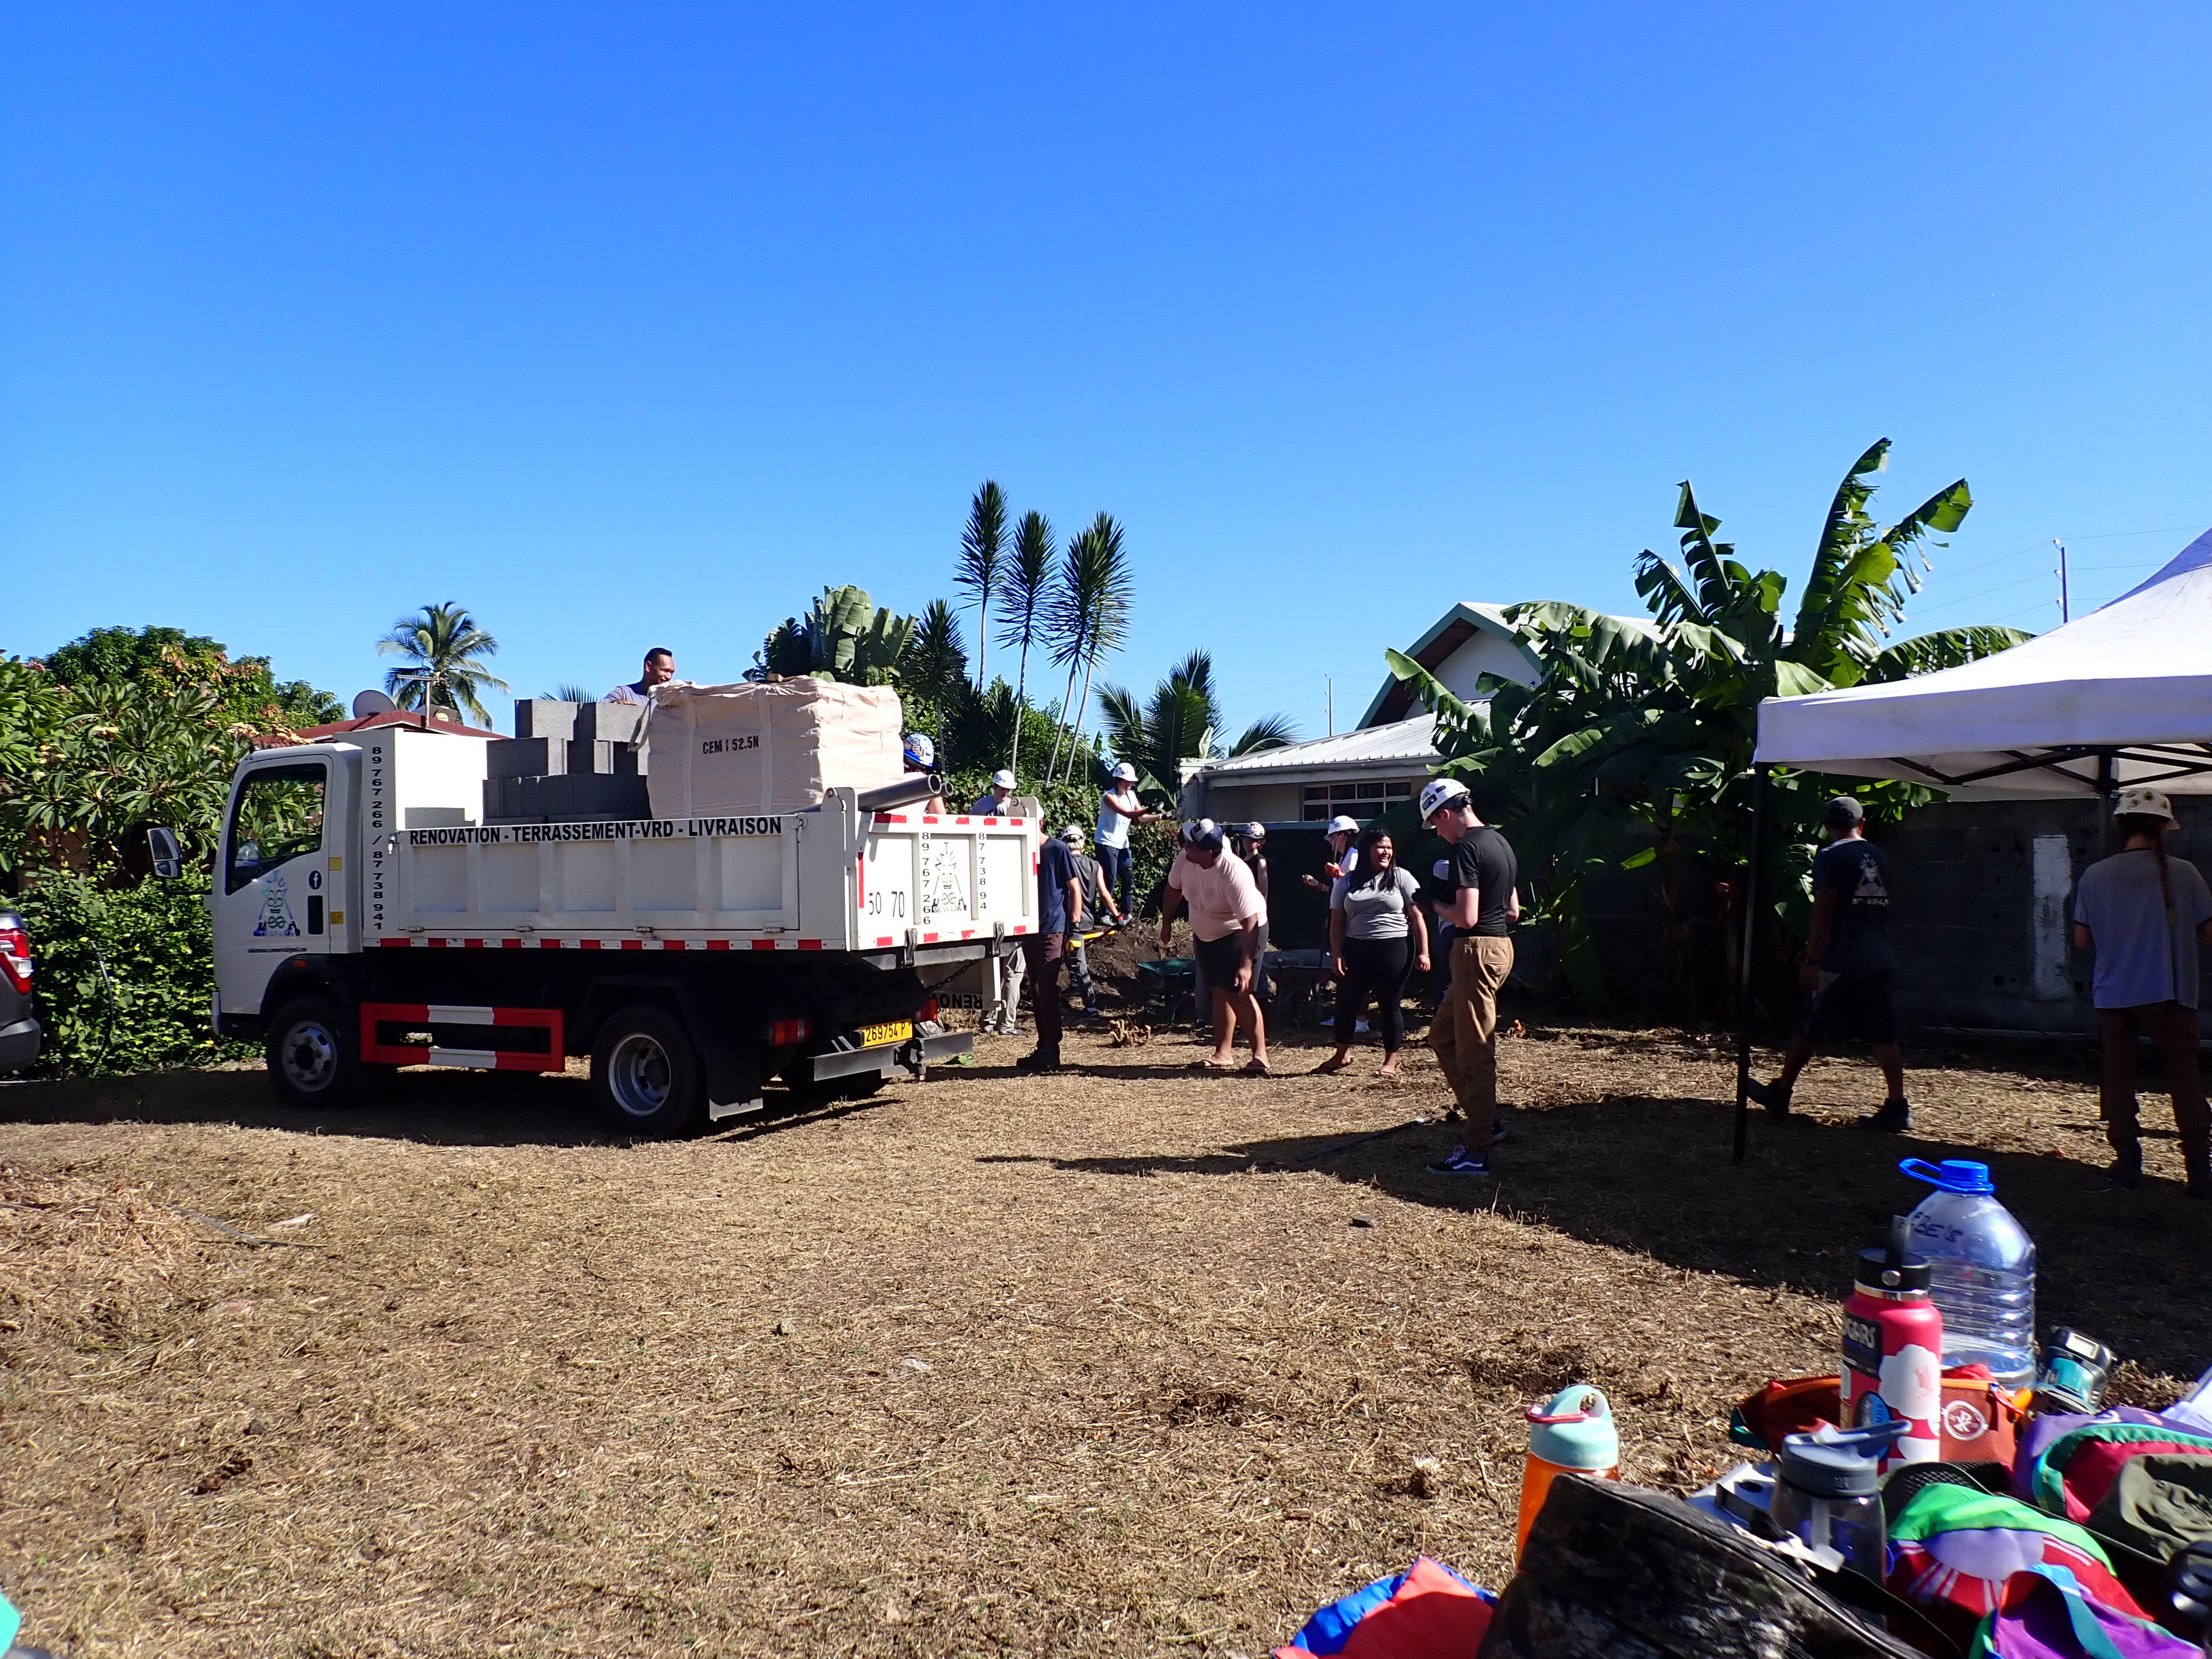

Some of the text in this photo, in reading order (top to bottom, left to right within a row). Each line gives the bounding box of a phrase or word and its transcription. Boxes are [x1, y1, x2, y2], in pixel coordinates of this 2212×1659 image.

[372, 747, 382, 764] 89
[702, 740, 722, 754] CEM
[732, 735, 759, 751] 52.5N
[372, 769, 382, 796] 767
[372, 801, 383, 828] 266
[410, 827, 500, 845] RENOVATION
[688, 816, 781, 836] LIVRAISON
[979, 832, 985, 851] 87
[373, 851, 383, 868] 87
[373, 873, 384, 899] 738
[921, 832, 931, 925] 89 767 266
[373, 904, 384, 930] 941
[869, 891, 905, 918] 50 70
[937, 994, 983, 1009] RENO
[865, 1021, 905, 1042] 269754 P
